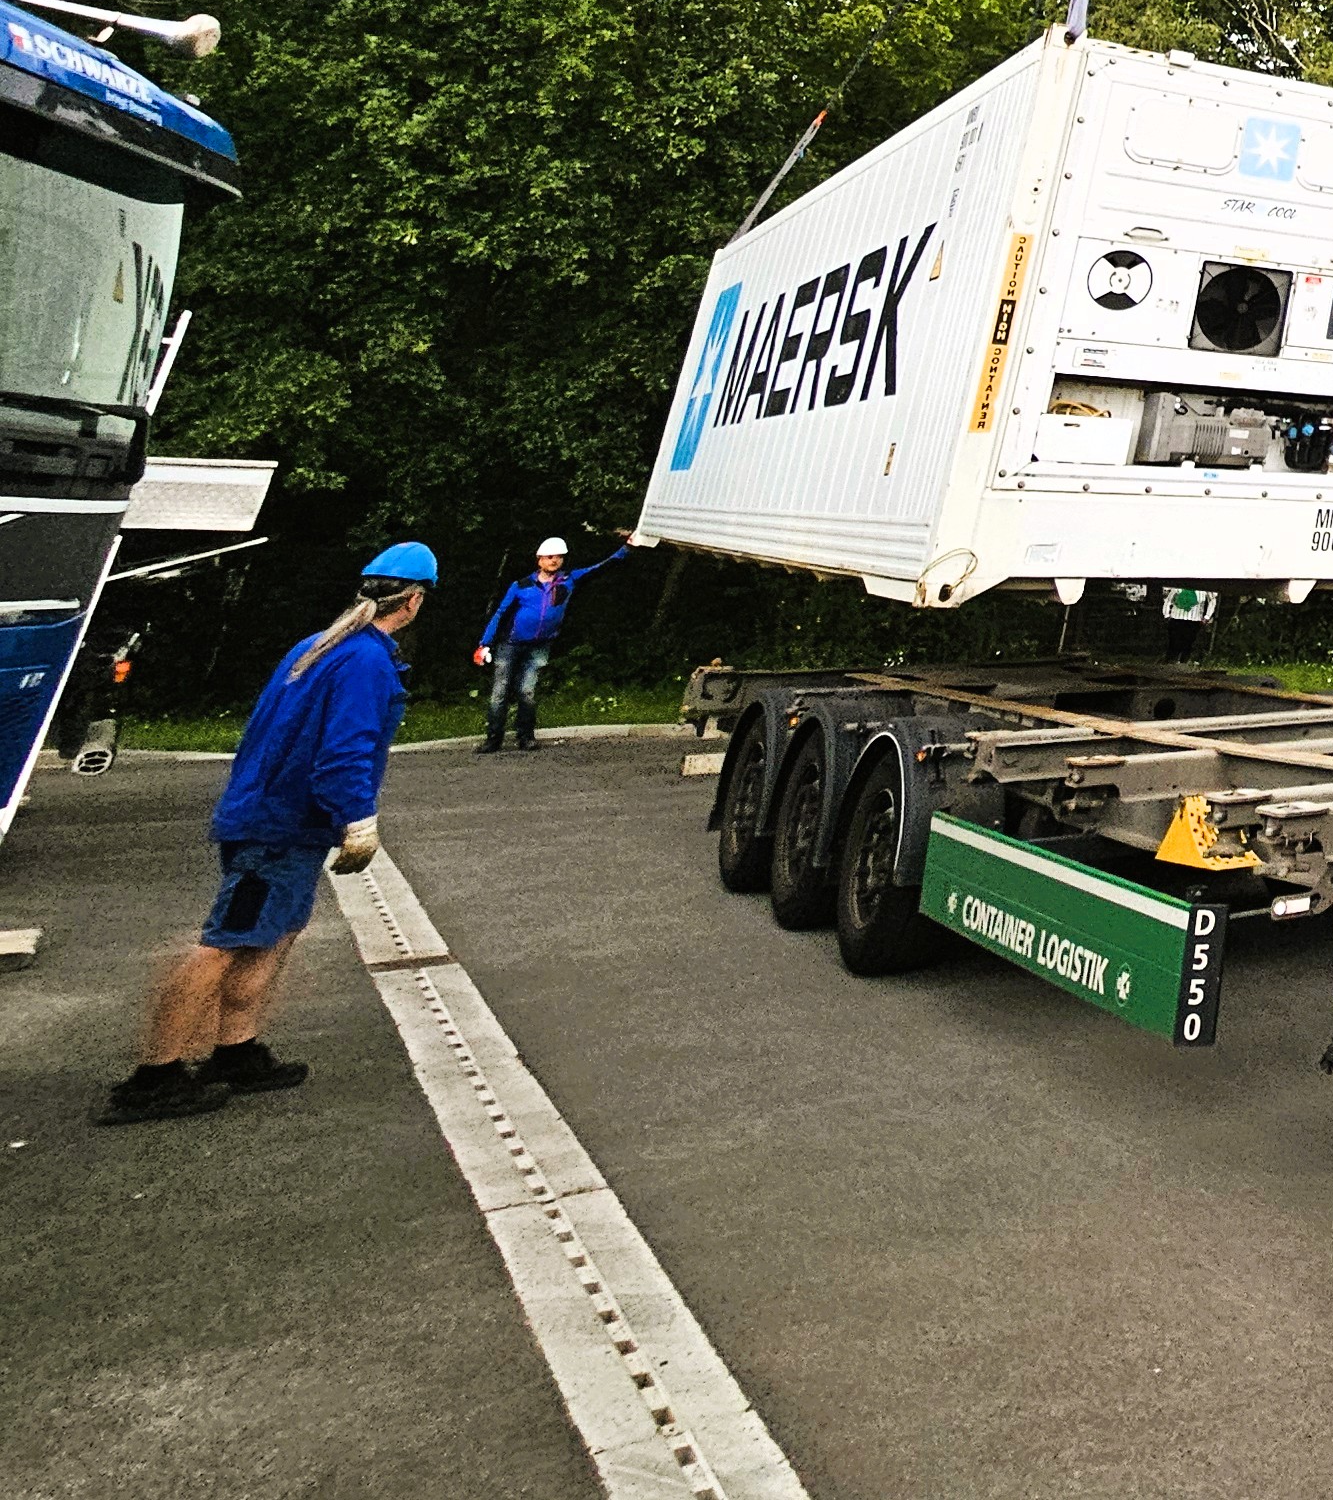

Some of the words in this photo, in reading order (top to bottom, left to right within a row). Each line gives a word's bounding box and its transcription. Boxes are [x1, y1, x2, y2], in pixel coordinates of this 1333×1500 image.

[33, 34, 152, 104] SCHWARZE
[1221, 199, 1255, 214] STAR
[1267, 206, 1296, 219] COOL
[713, 221, 938, 428] MAERSK
[962, 895, 1035, 958] CONTAINER
[1037, 929, 1109, 995] LOGISTIK
